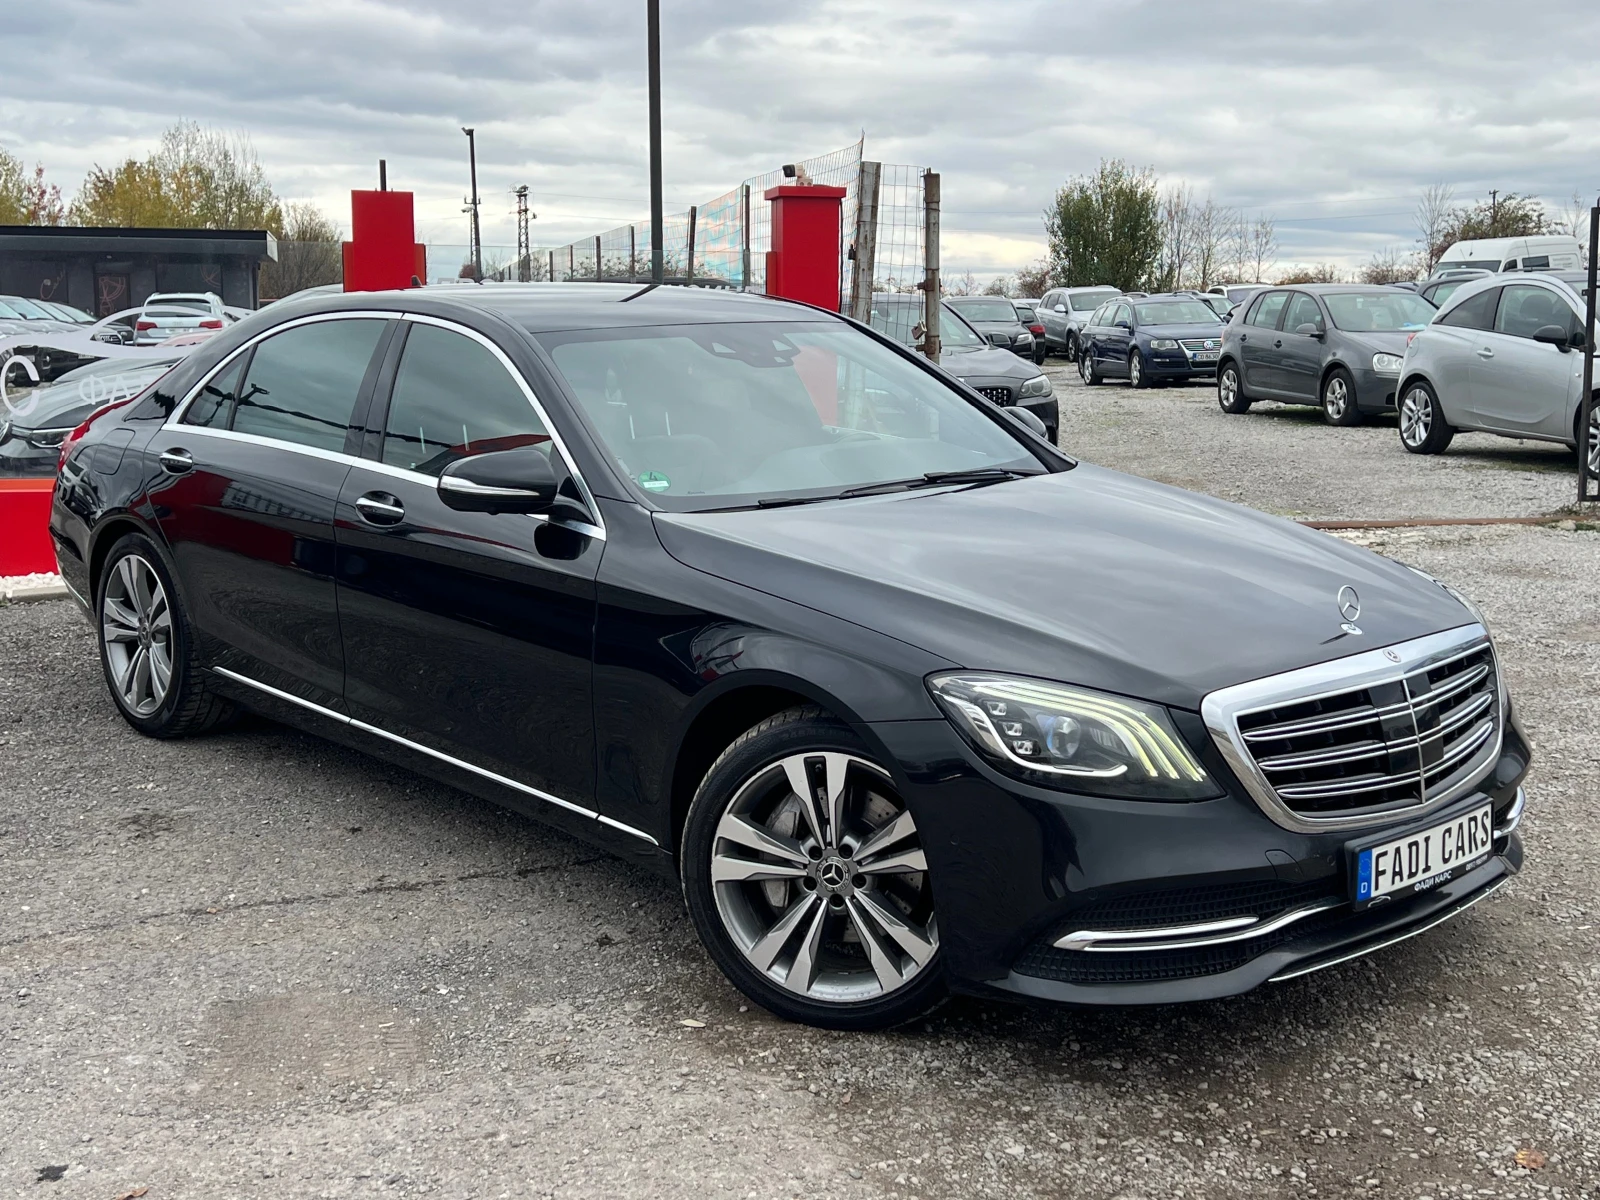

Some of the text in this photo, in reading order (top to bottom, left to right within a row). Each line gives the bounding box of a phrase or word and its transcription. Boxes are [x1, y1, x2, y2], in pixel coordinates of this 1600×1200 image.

[1374, 811, 1489, 891] FADI CARS
[1361, 882, 1368, 893] D
[1414, 870, 1452, 891] ФАДИ КАРС
